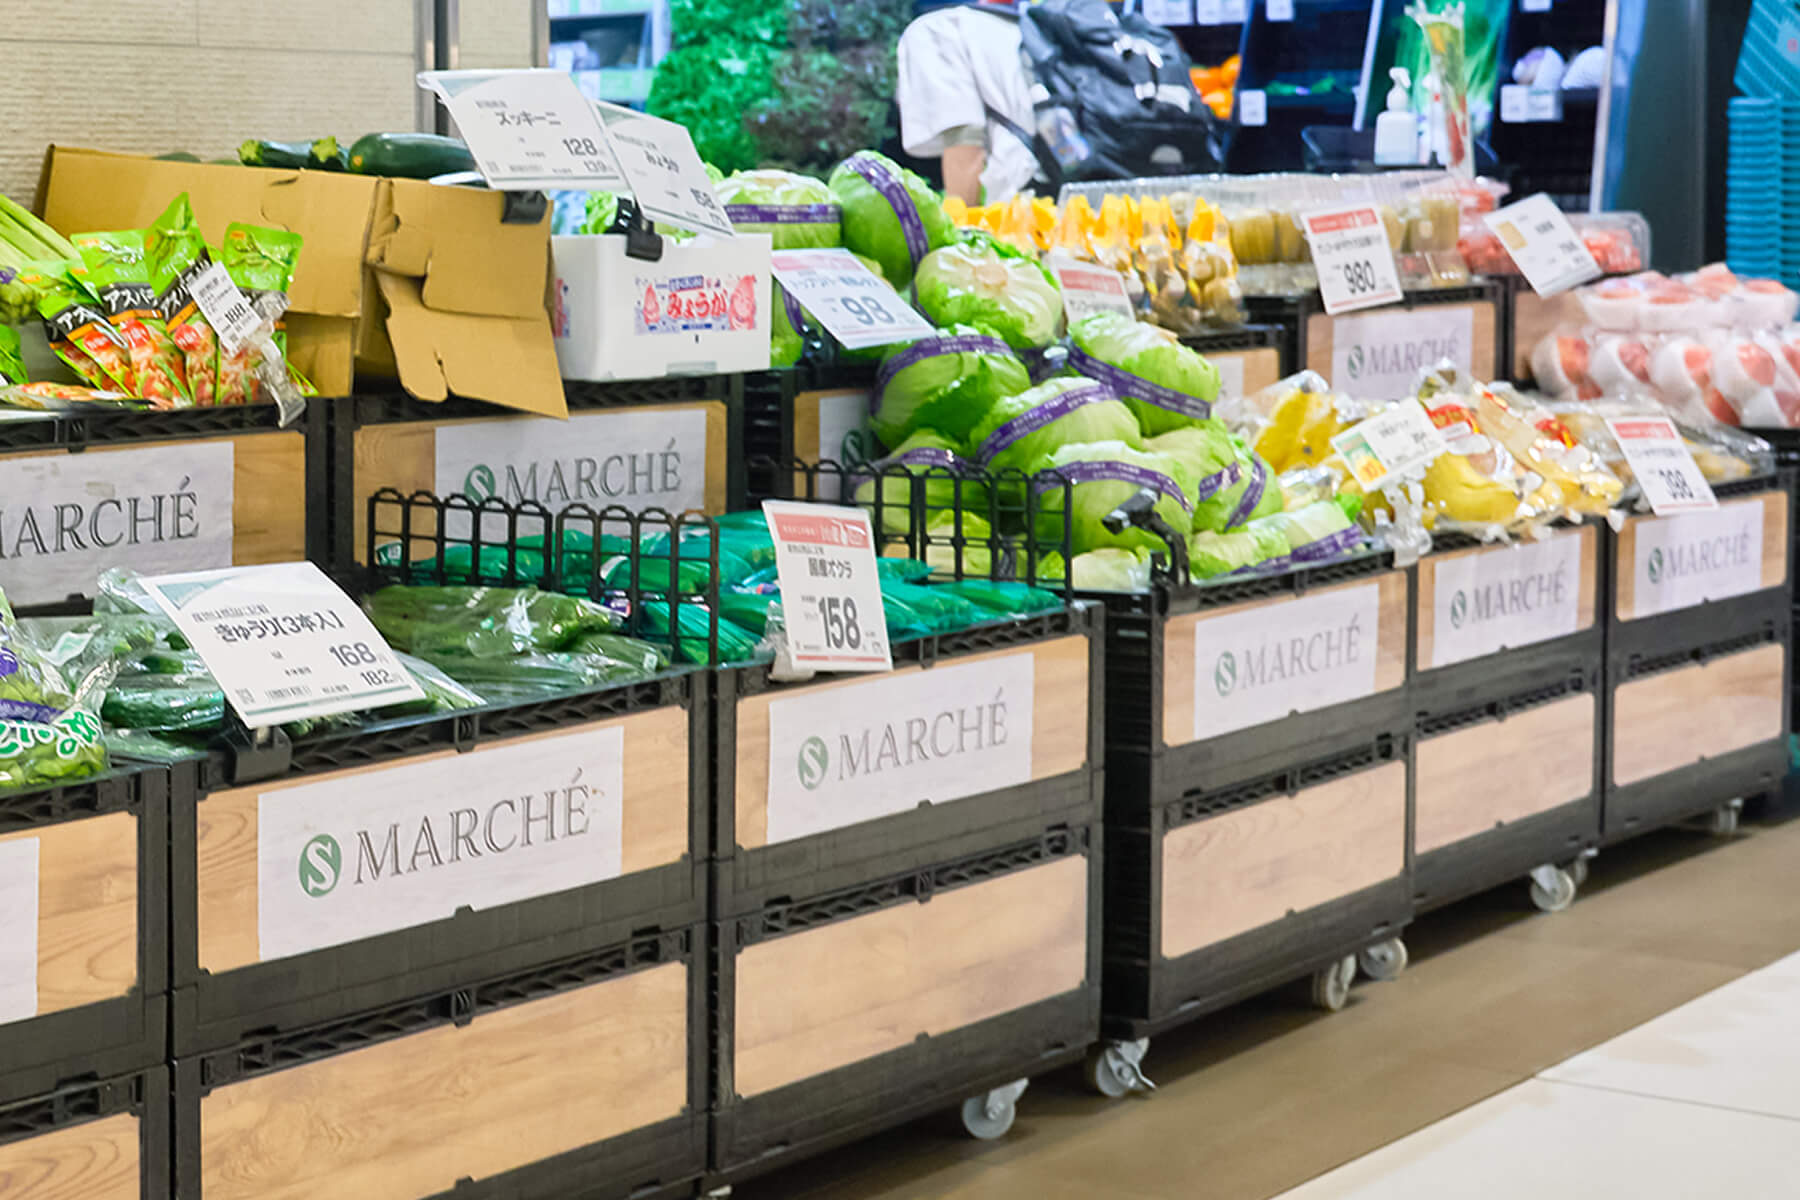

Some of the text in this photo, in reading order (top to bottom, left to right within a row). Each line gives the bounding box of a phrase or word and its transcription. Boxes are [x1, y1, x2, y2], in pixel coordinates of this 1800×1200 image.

[563, 137, 598, 156] 128
[1343, 259, 1376, 295] 980
[666, 290, 728, 319] みょうが
[839, 295, 896, 326] 98
[505, 436, 682, 502] MARCHÉ
[1666, 521, 1751, 580] MARCHÉ
[1472, 559, 1566, 624] MARCHÉ
[818, 596, 862, 650] 158
[329, 641, 377, 668] 168
[359, 668, 393, 688] 182
[1241, 612, 1361, 690] MARCHÉ
[838, 685, 1009, 781] MARCHÉ
[353, 766, 593, 885] MARCHÉ
